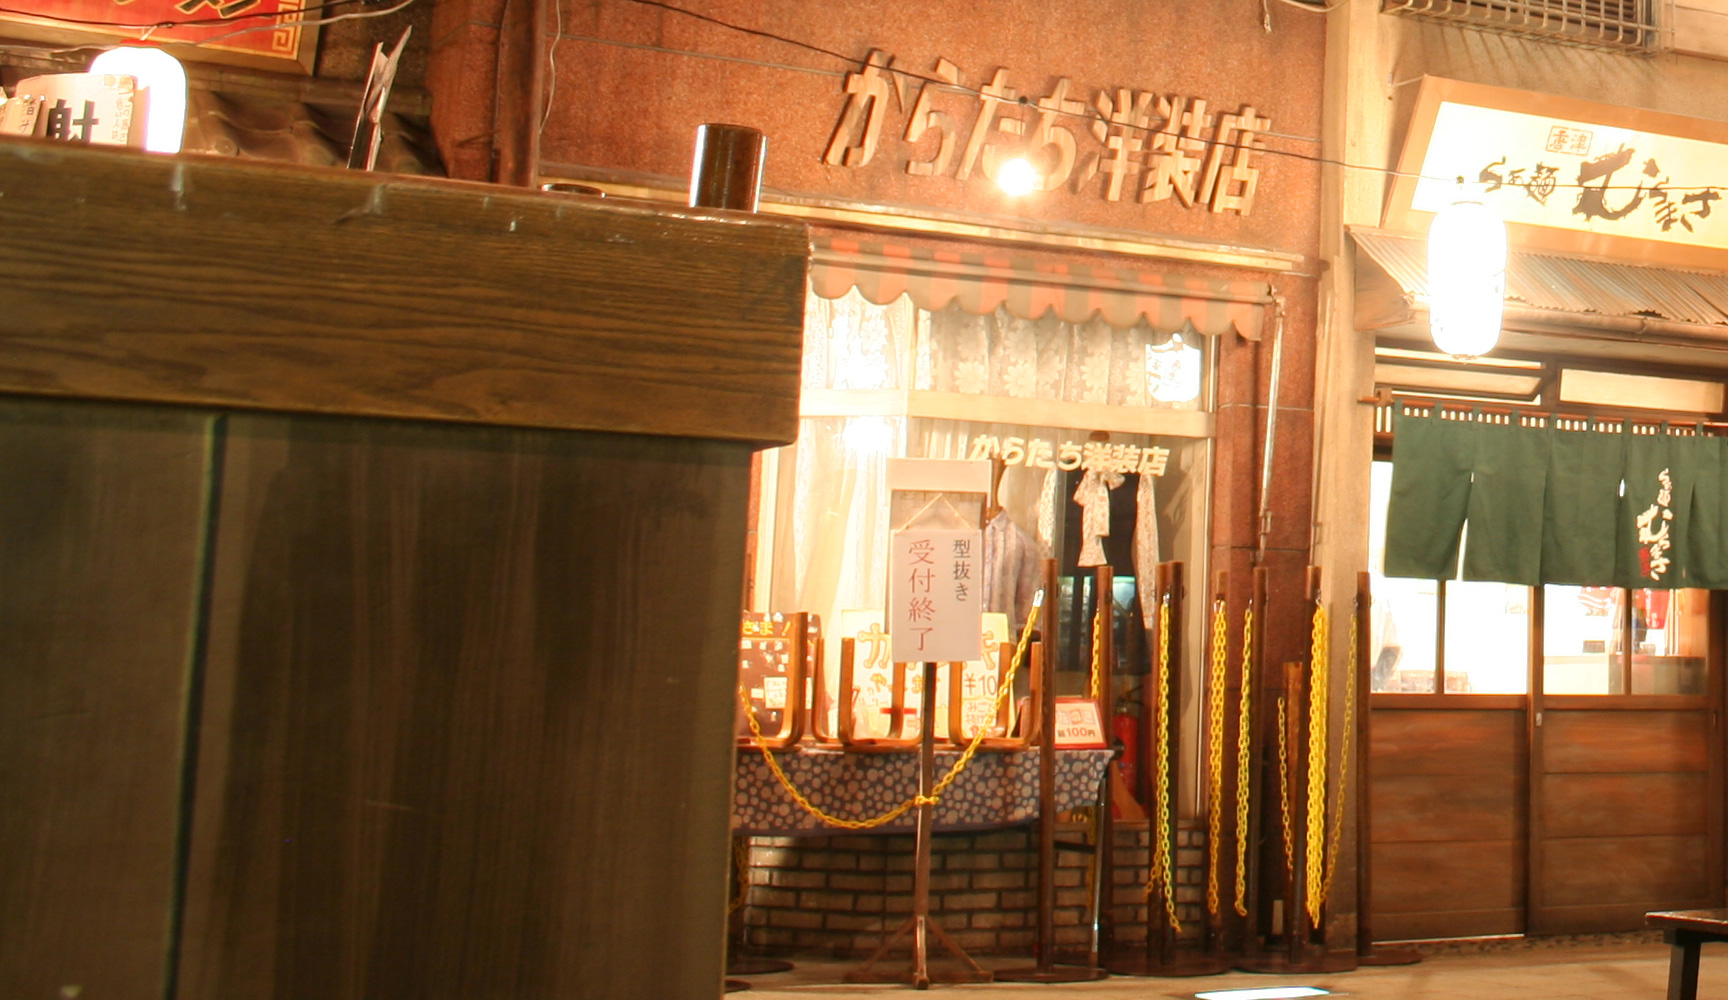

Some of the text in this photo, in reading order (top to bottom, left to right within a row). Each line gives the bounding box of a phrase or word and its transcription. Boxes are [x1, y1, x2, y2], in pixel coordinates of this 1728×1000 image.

[822, 48, 1271, 217] からたち洋装店
[969, 433, 1170, 477] からたち洋装店
[907, 538, 937, 652] 受付終了
[953, 538, 971, 602] 型抜き
